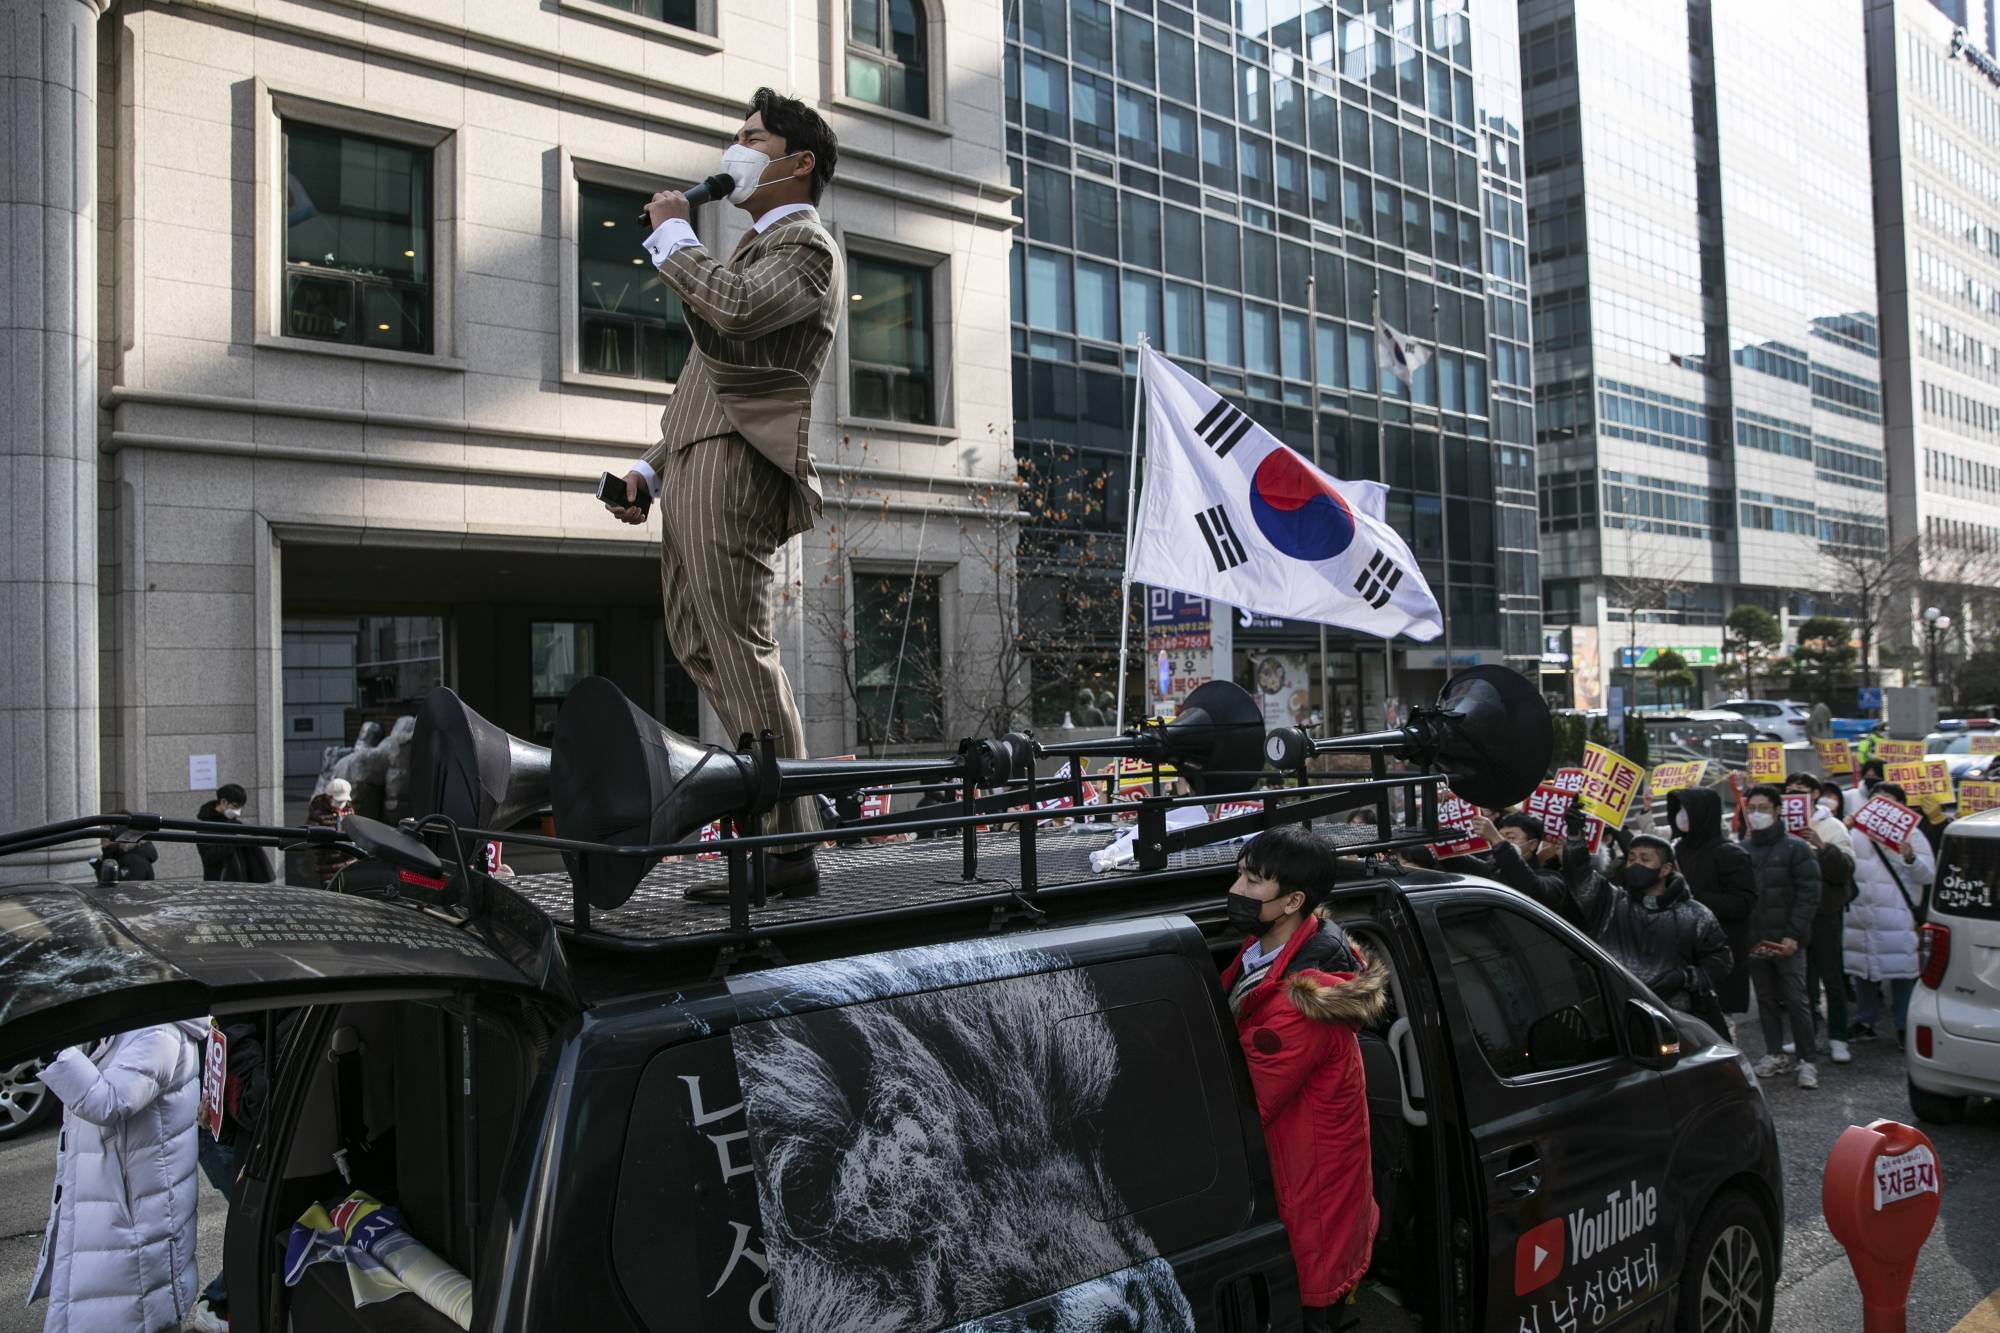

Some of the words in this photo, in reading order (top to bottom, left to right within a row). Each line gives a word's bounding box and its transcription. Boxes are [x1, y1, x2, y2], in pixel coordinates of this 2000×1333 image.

[1583, 749, 1636, 791] 미니즘
[1887, 764, 1944, 782] 페미니즘
[1581, 775, 1627, 812] 한다
[1903, 781, 1947, 795] 탄한다
[1855, 810, 1905, 842] 중단하라
[1866, 799, 1914, 831] 남성혐오
[1568, 1180, 1657, 1265] YouTube
